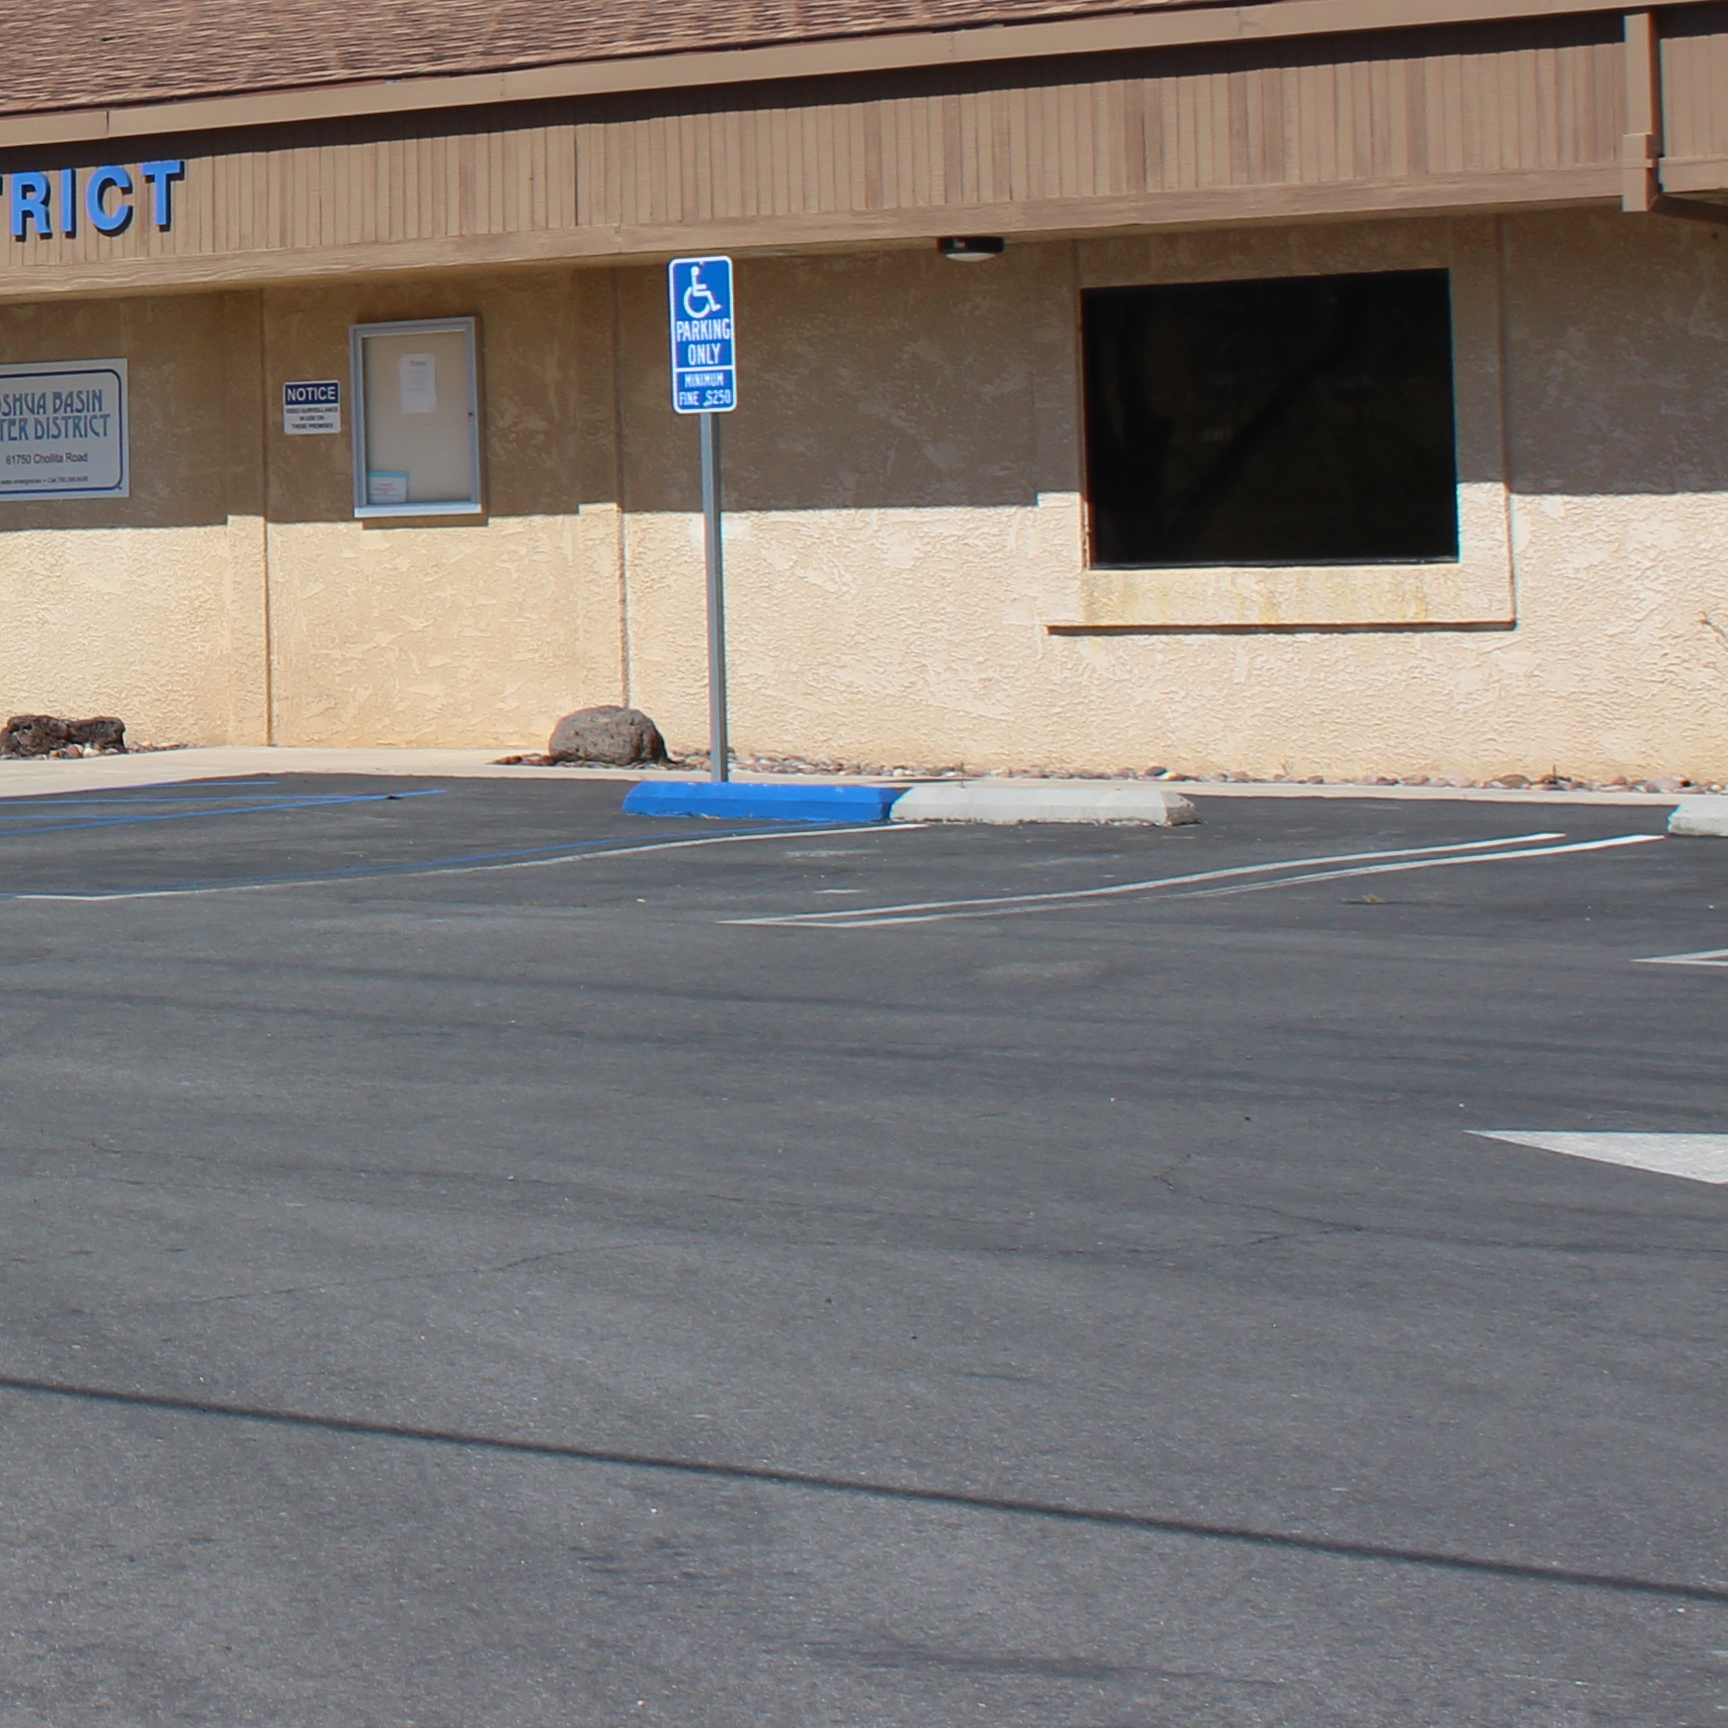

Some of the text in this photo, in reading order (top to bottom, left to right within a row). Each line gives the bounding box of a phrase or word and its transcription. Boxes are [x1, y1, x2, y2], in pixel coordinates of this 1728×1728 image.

[676, 318, 730, 342] PARKING
[688, 343, 721, 365] ONLY
[684, 372, 724, 388] MINIMUM
[52, 389, 103, 414] BASIN
[287, 386, 337, 402] NOTICE
[679, 389, 731, 406] FINE $250
[34, 414, 111, 440] DISTRICT
[5, 454, 31, 465] 61750
[65, 451, 88, 463] Road
